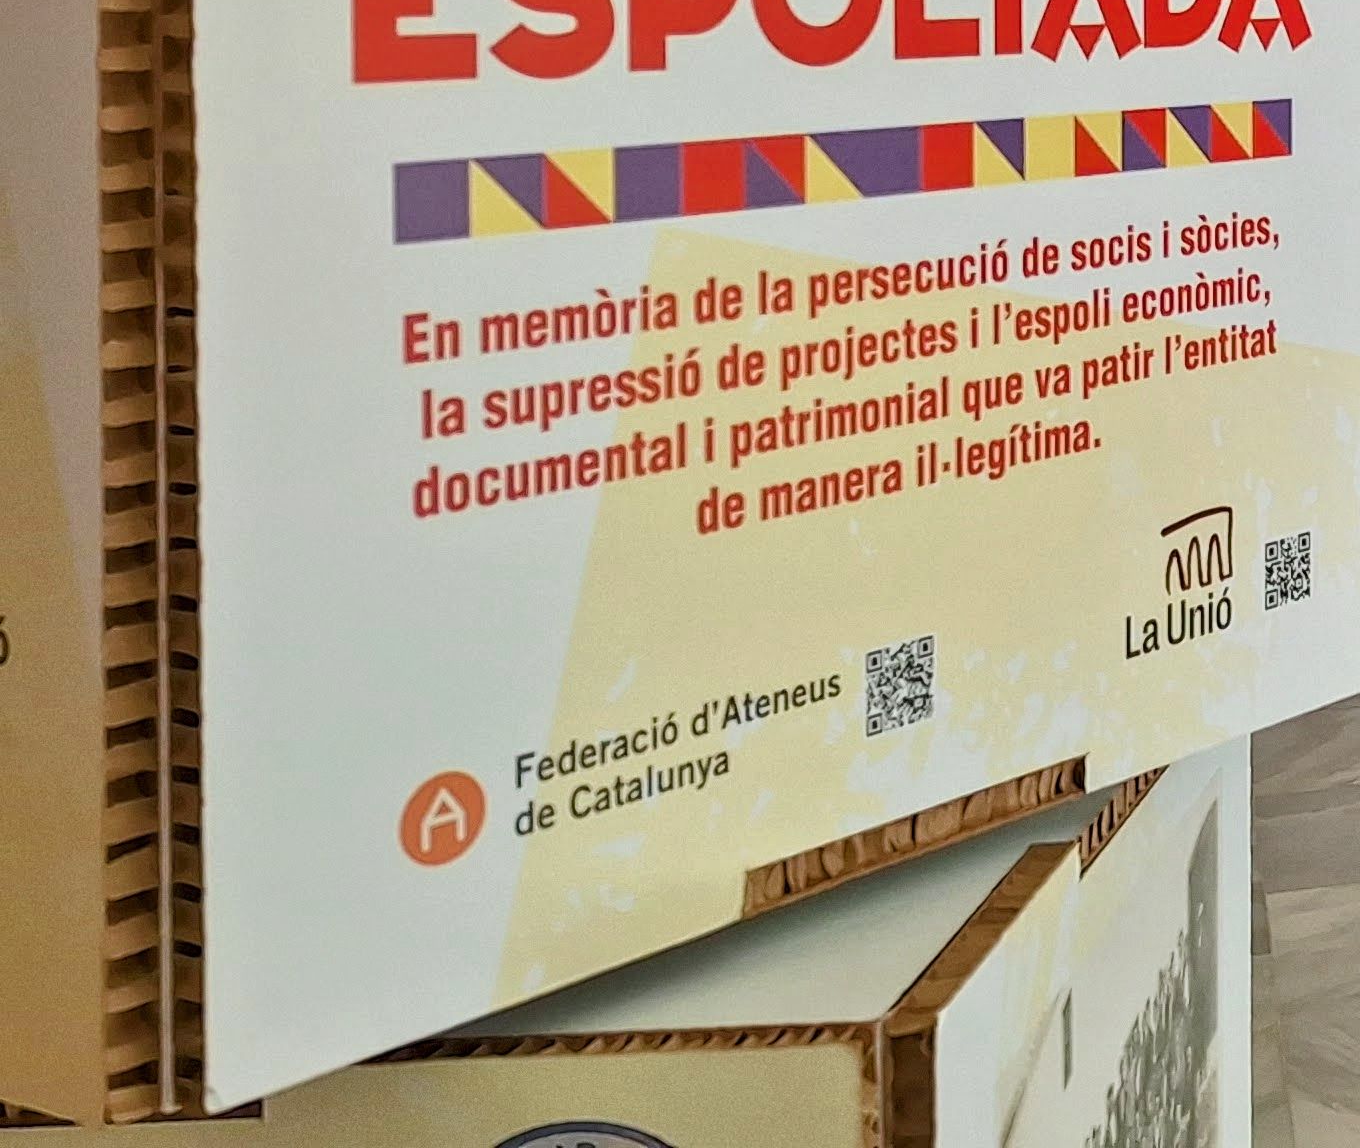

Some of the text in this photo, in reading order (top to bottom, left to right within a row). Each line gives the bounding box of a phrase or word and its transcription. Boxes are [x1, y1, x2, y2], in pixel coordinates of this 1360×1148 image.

[403, 212, 1281, 364] En memòria de la persecució de socis i sòcies,
[422, 268, 1272, 439] la supressió de projectes i l'espoli econòmic,
[413, 321, 1278, 519] documental i patrimonial que va patir l'entitat
[696, 420, 1102, 536] de manera il·legítima.
[1124, 591, 1234, 660] La Unió
[514, 671, 842, 789] Federació d'Ateneus
[514, 747, 731, 837] de Catalunya
